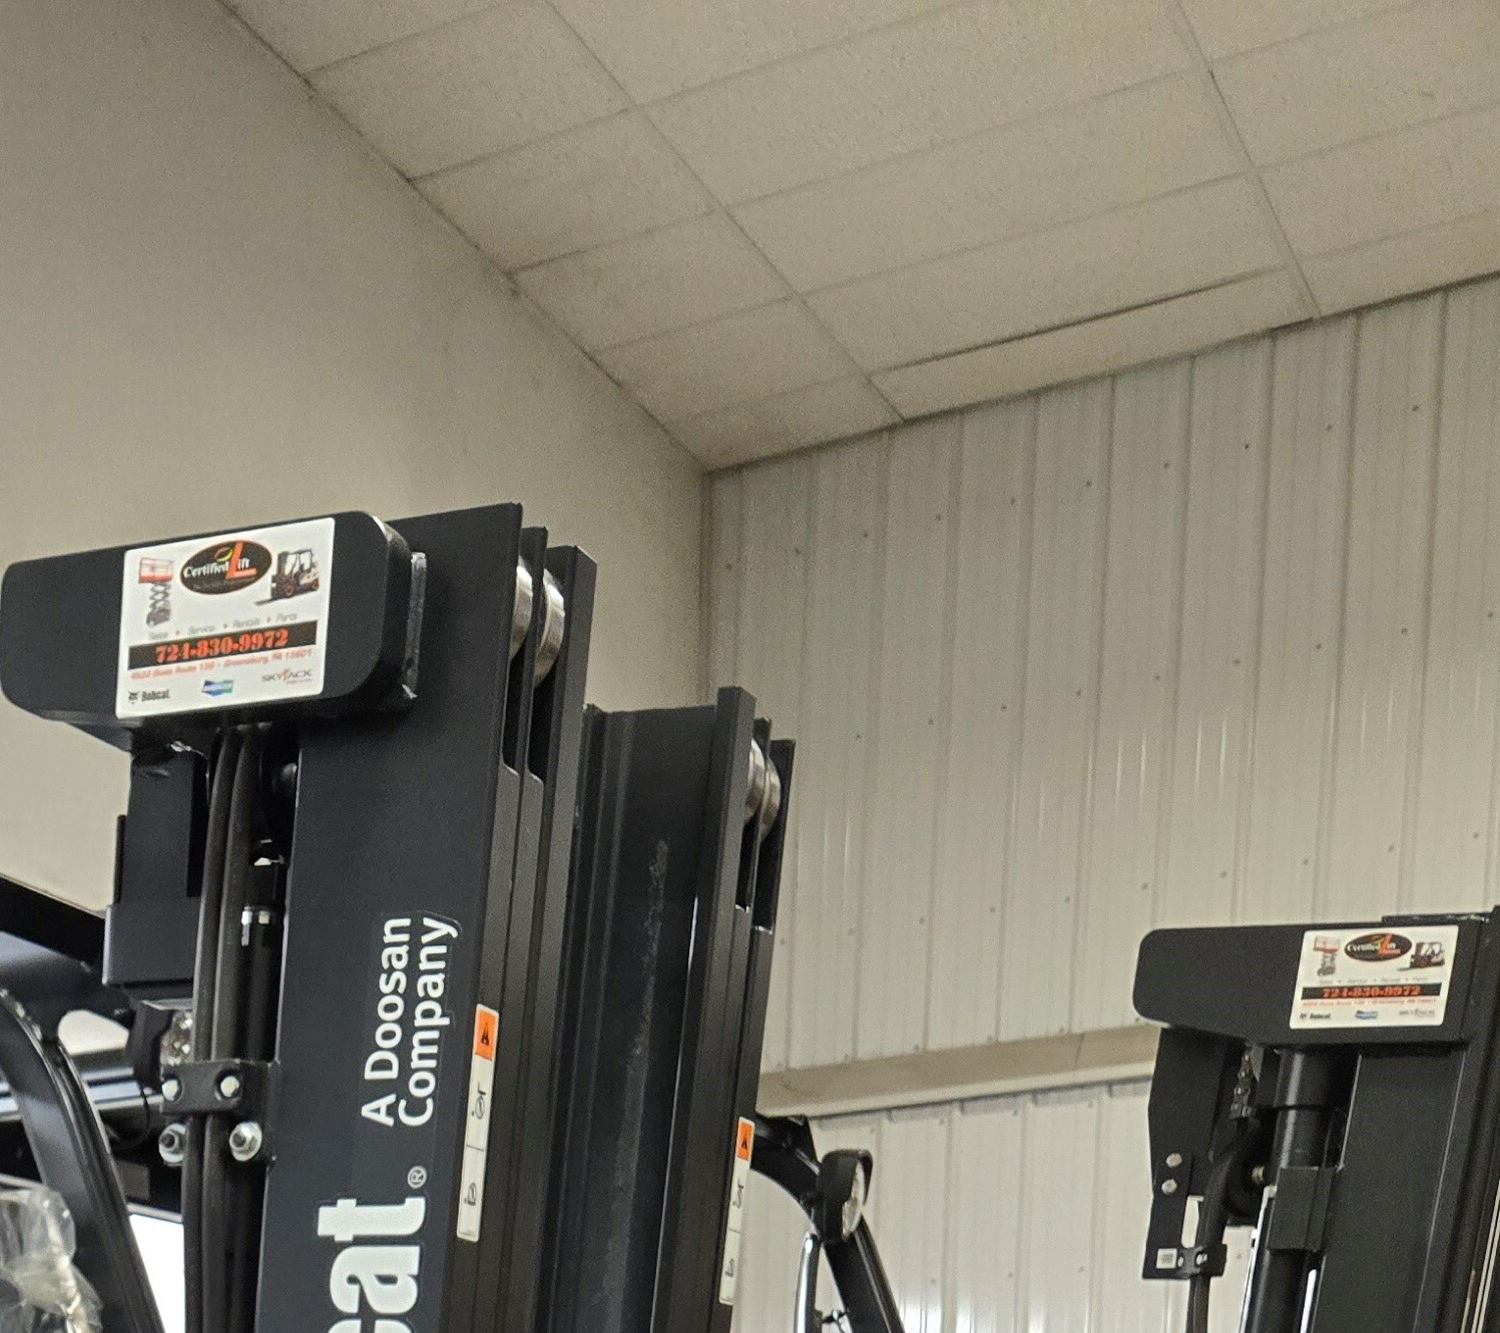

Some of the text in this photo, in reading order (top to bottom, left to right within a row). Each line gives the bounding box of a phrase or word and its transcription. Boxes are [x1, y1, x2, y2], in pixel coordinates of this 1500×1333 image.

[155, 628, 289, 664] 724-830-9972
[360, 916, 412, 1127] A Doosan
[398, 917, 458, 1127] Company
